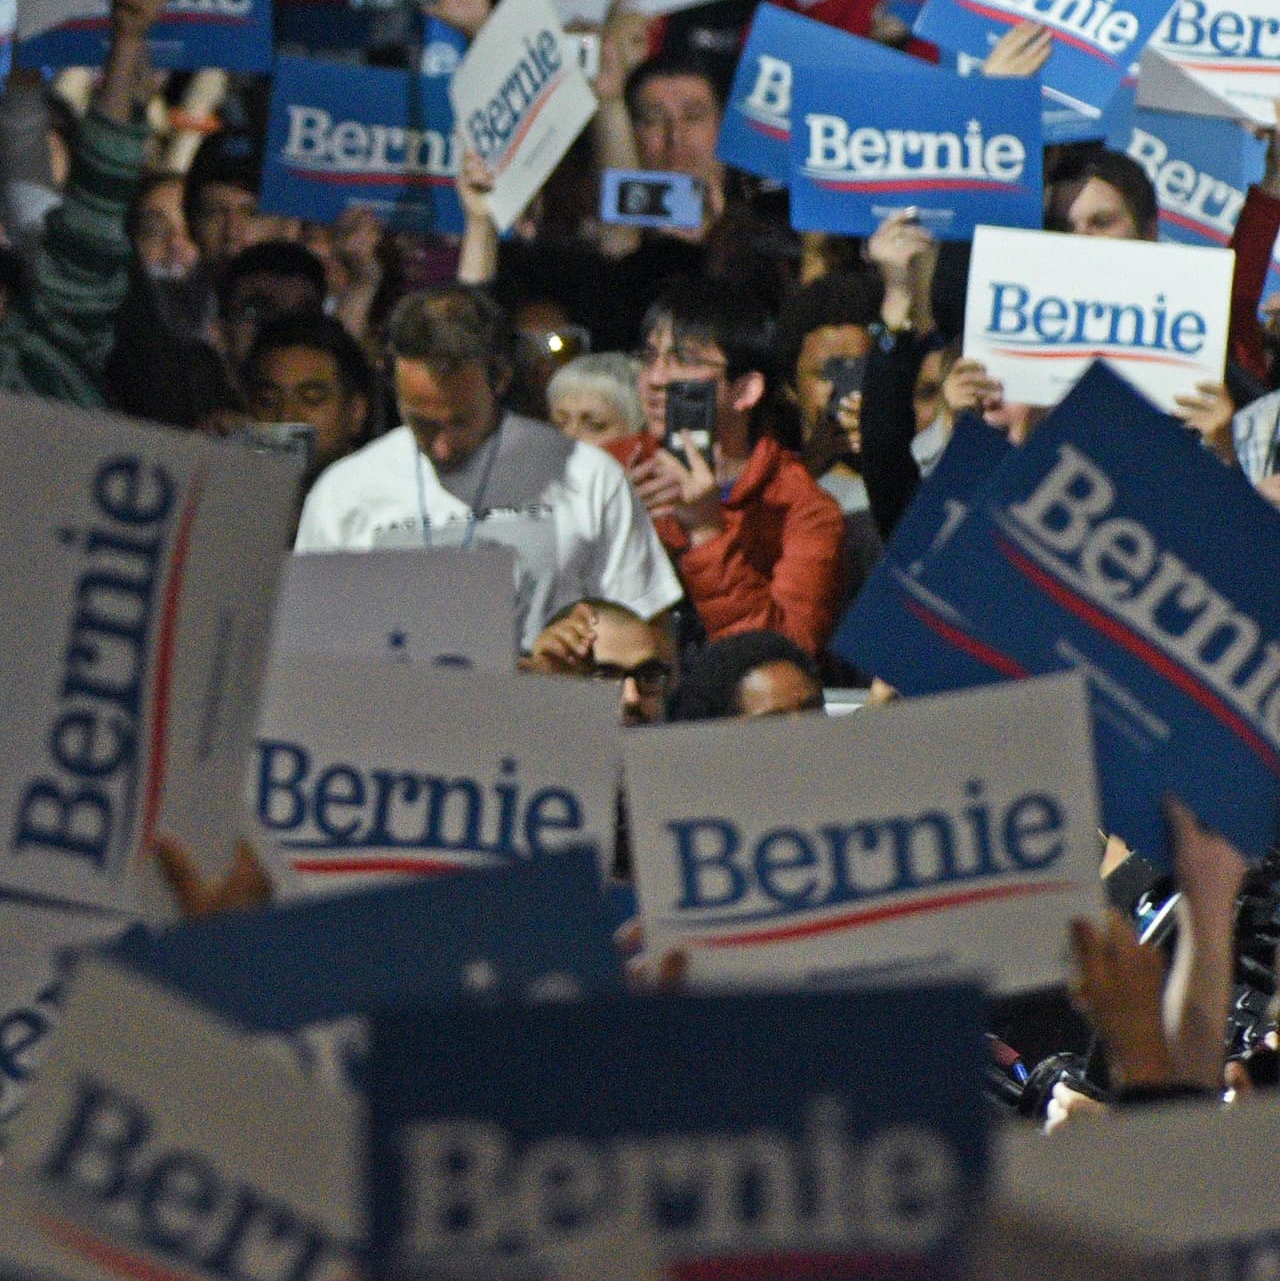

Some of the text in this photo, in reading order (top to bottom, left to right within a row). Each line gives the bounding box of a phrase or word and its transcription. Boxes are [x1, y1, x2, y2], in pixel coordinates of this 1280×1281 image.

[468, 24, 565, 160] Bernie
[802, 112, 1026, 188] Bernie
[985, 280, 1207, 356] Bernie
[13, 450, 177, 873] Bernie
[253, 736, 587, 856] Bernie
[666, 778, 1069, 914] Bernie
[396, 1088, 966, 1263] Bernie
